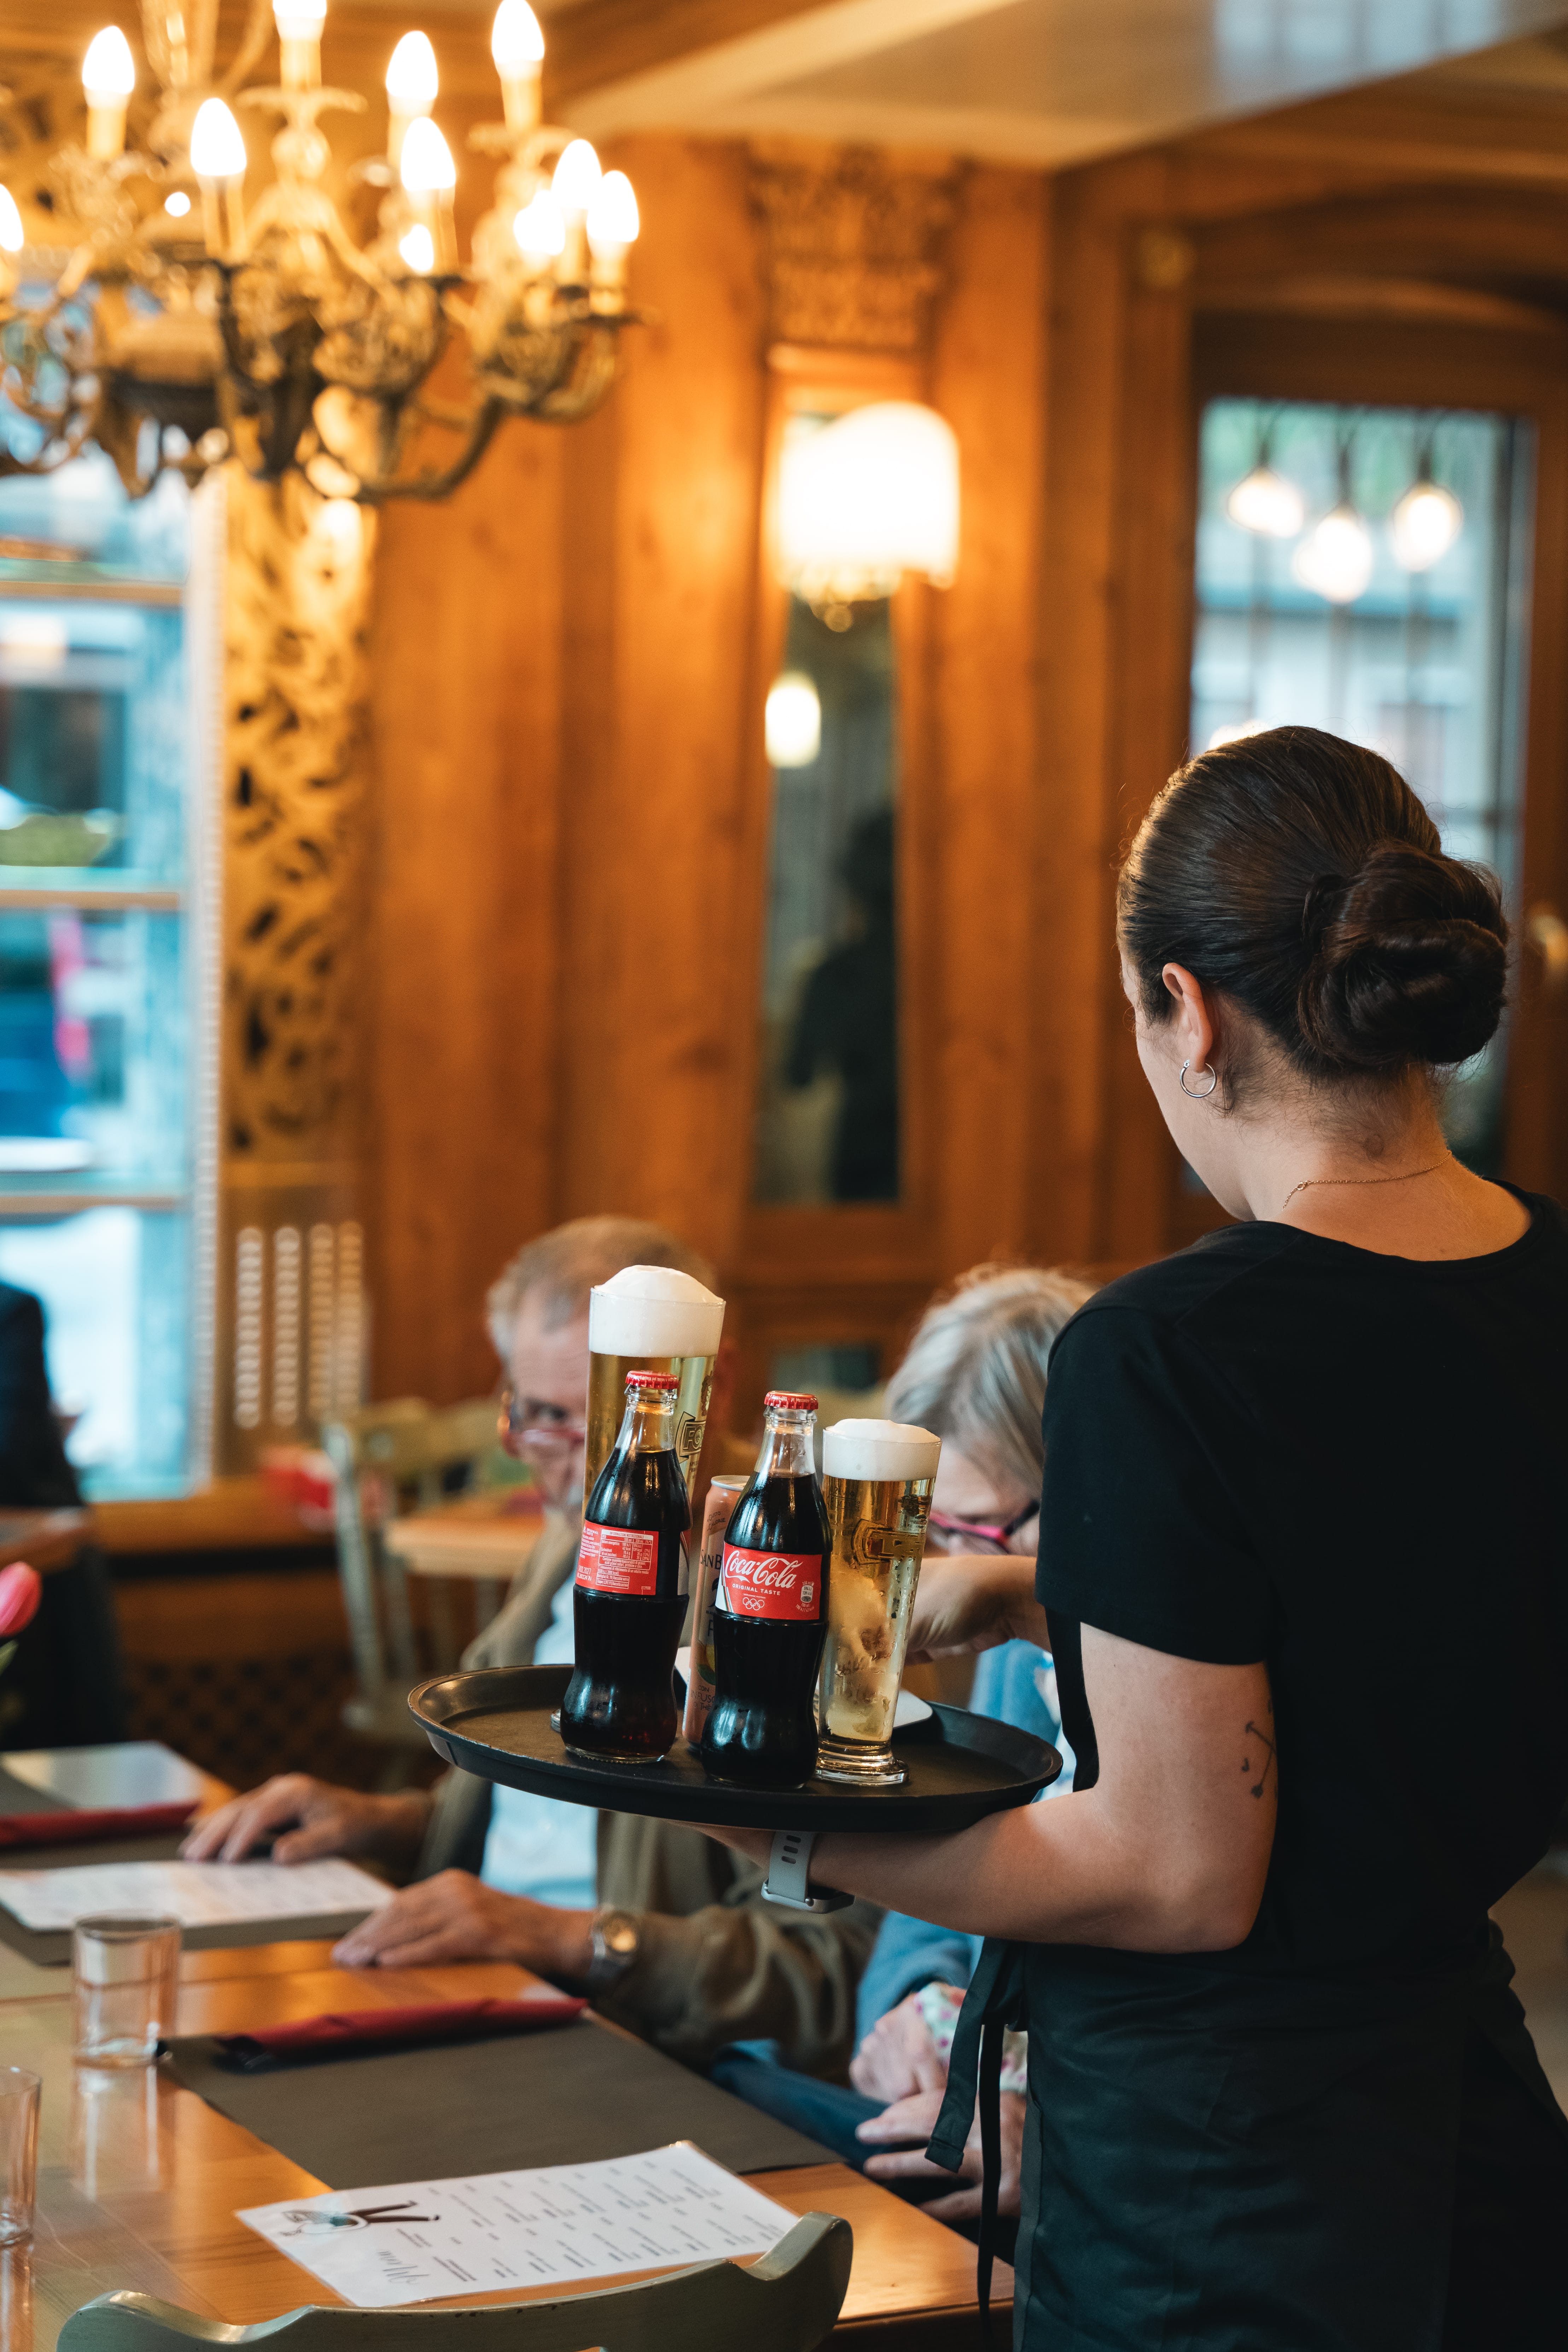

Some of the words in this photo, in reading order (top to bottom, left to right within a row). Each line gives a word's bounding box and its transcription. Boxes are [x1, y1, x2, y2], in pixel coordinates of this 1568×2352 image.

[709, 1511, 721, 1521] GUSTO
[709, 1518, 725, 1530] CALORIE
[725, 1550, 803, 1588] Coca-Cola
[732, 1583, 758, 1592] ORIGINAL
